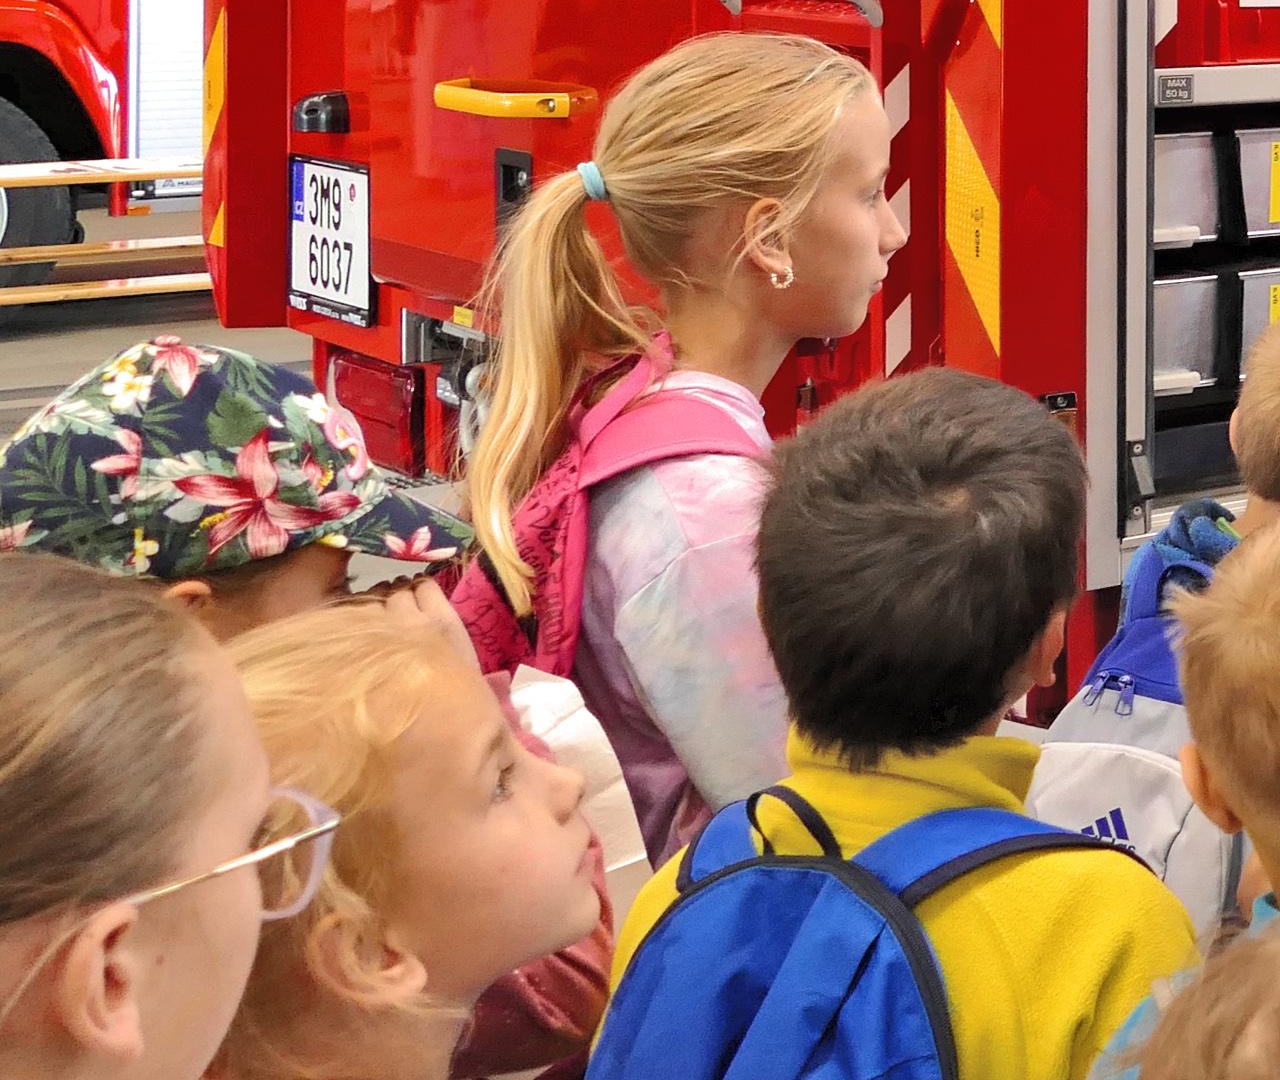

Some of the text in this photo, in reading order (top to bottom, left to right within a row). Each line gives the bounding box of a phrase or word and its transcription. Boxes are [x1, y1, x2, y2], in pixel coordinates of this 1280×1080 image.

[1167, 79, 1187, 87] MAX
[308, 173, 342, 231] 3M9
[308, 234, 353, 295] 6037
